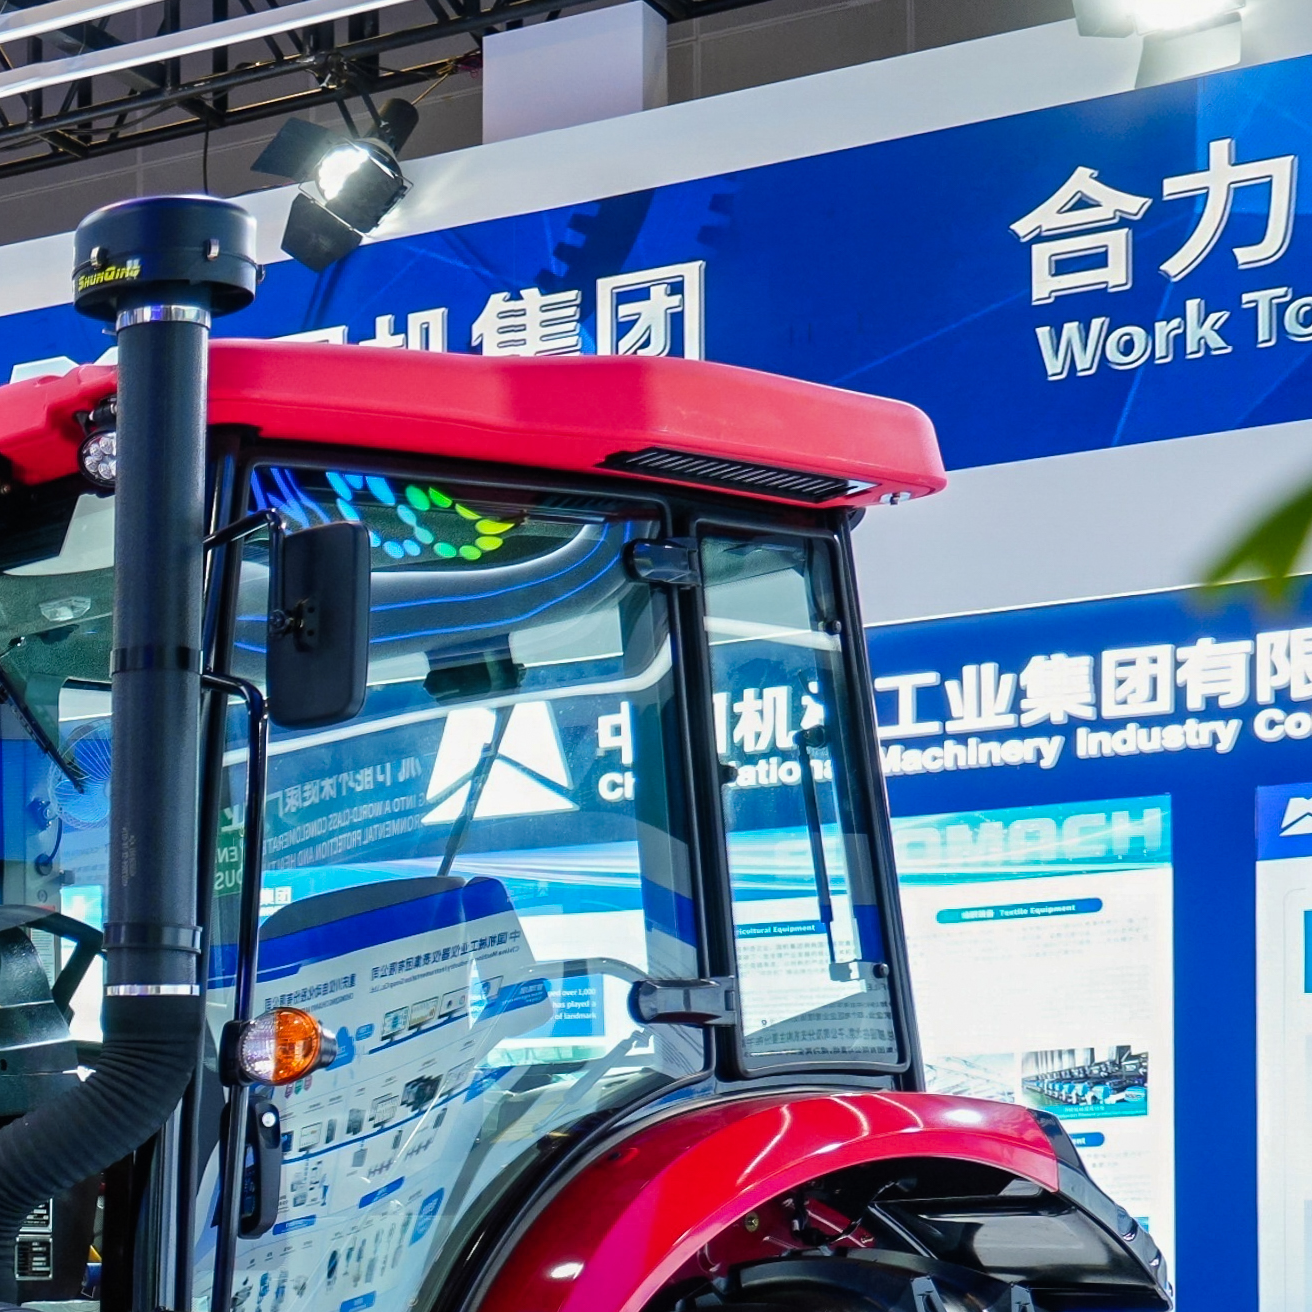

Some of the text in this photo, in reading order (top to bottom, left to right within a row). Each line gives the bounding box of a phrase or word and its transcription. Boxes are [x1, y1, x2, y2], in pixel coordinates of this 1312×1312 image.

[1008, 137, 1299, 306] 合力
[272, 260, 707, 362] 集团
[1034, 298, 1233, 381] Work
[879, 734, 1065, 778] Machinery
[1076, 715, 1243, 759] Industry
[1030, 903, 1076, 915] Equipment
